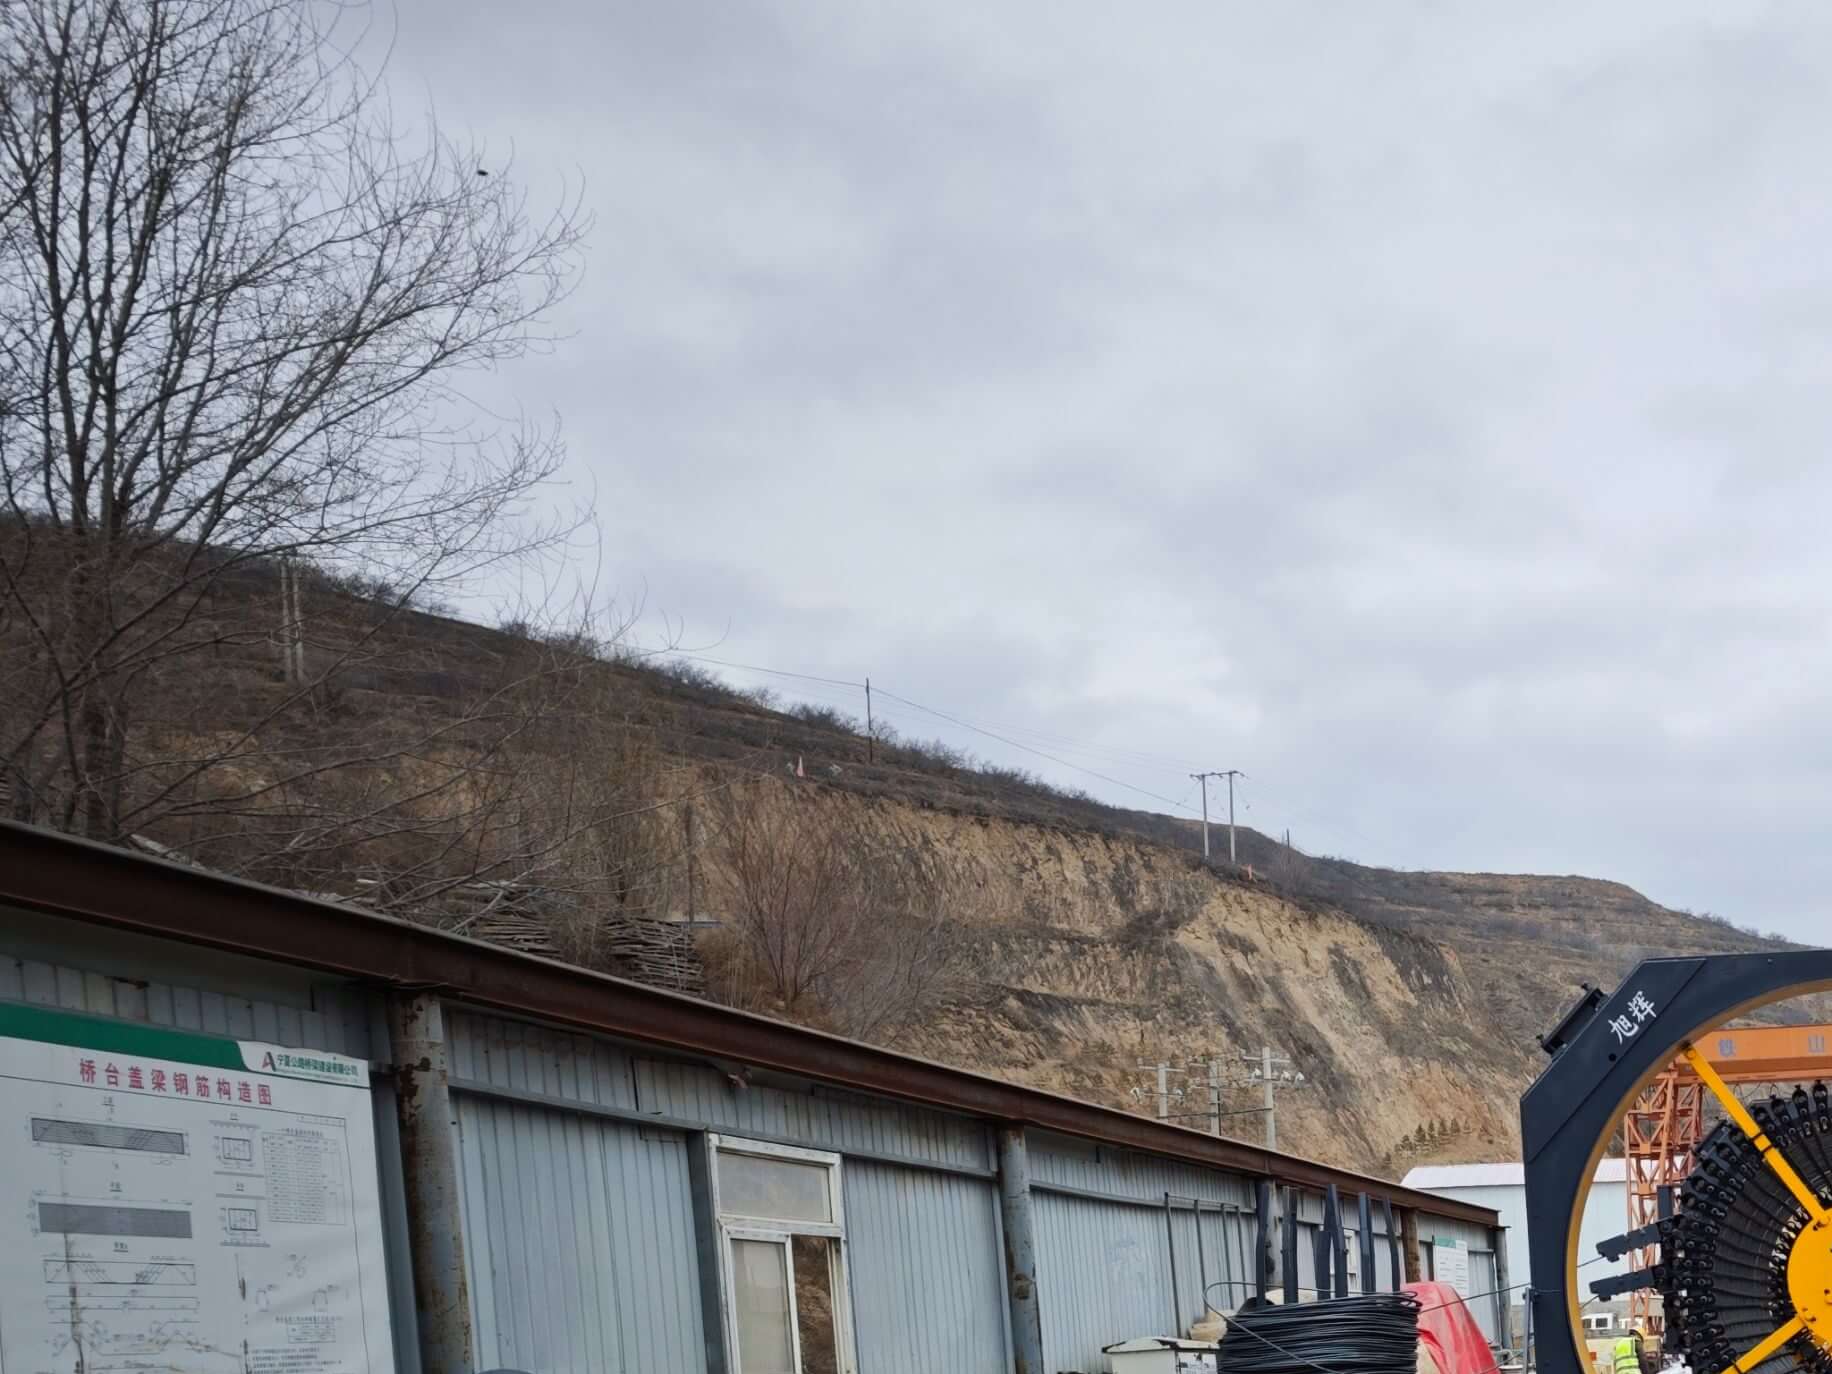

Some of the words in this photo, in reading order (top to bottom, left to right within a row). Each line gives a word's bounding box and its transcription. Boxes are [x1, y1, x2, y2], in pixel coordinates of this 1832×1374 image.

[1607, 990, 1657, 1046] 旭辉
[79, 1057, 273, 1106] 桥台盖梁钢筋构造图
